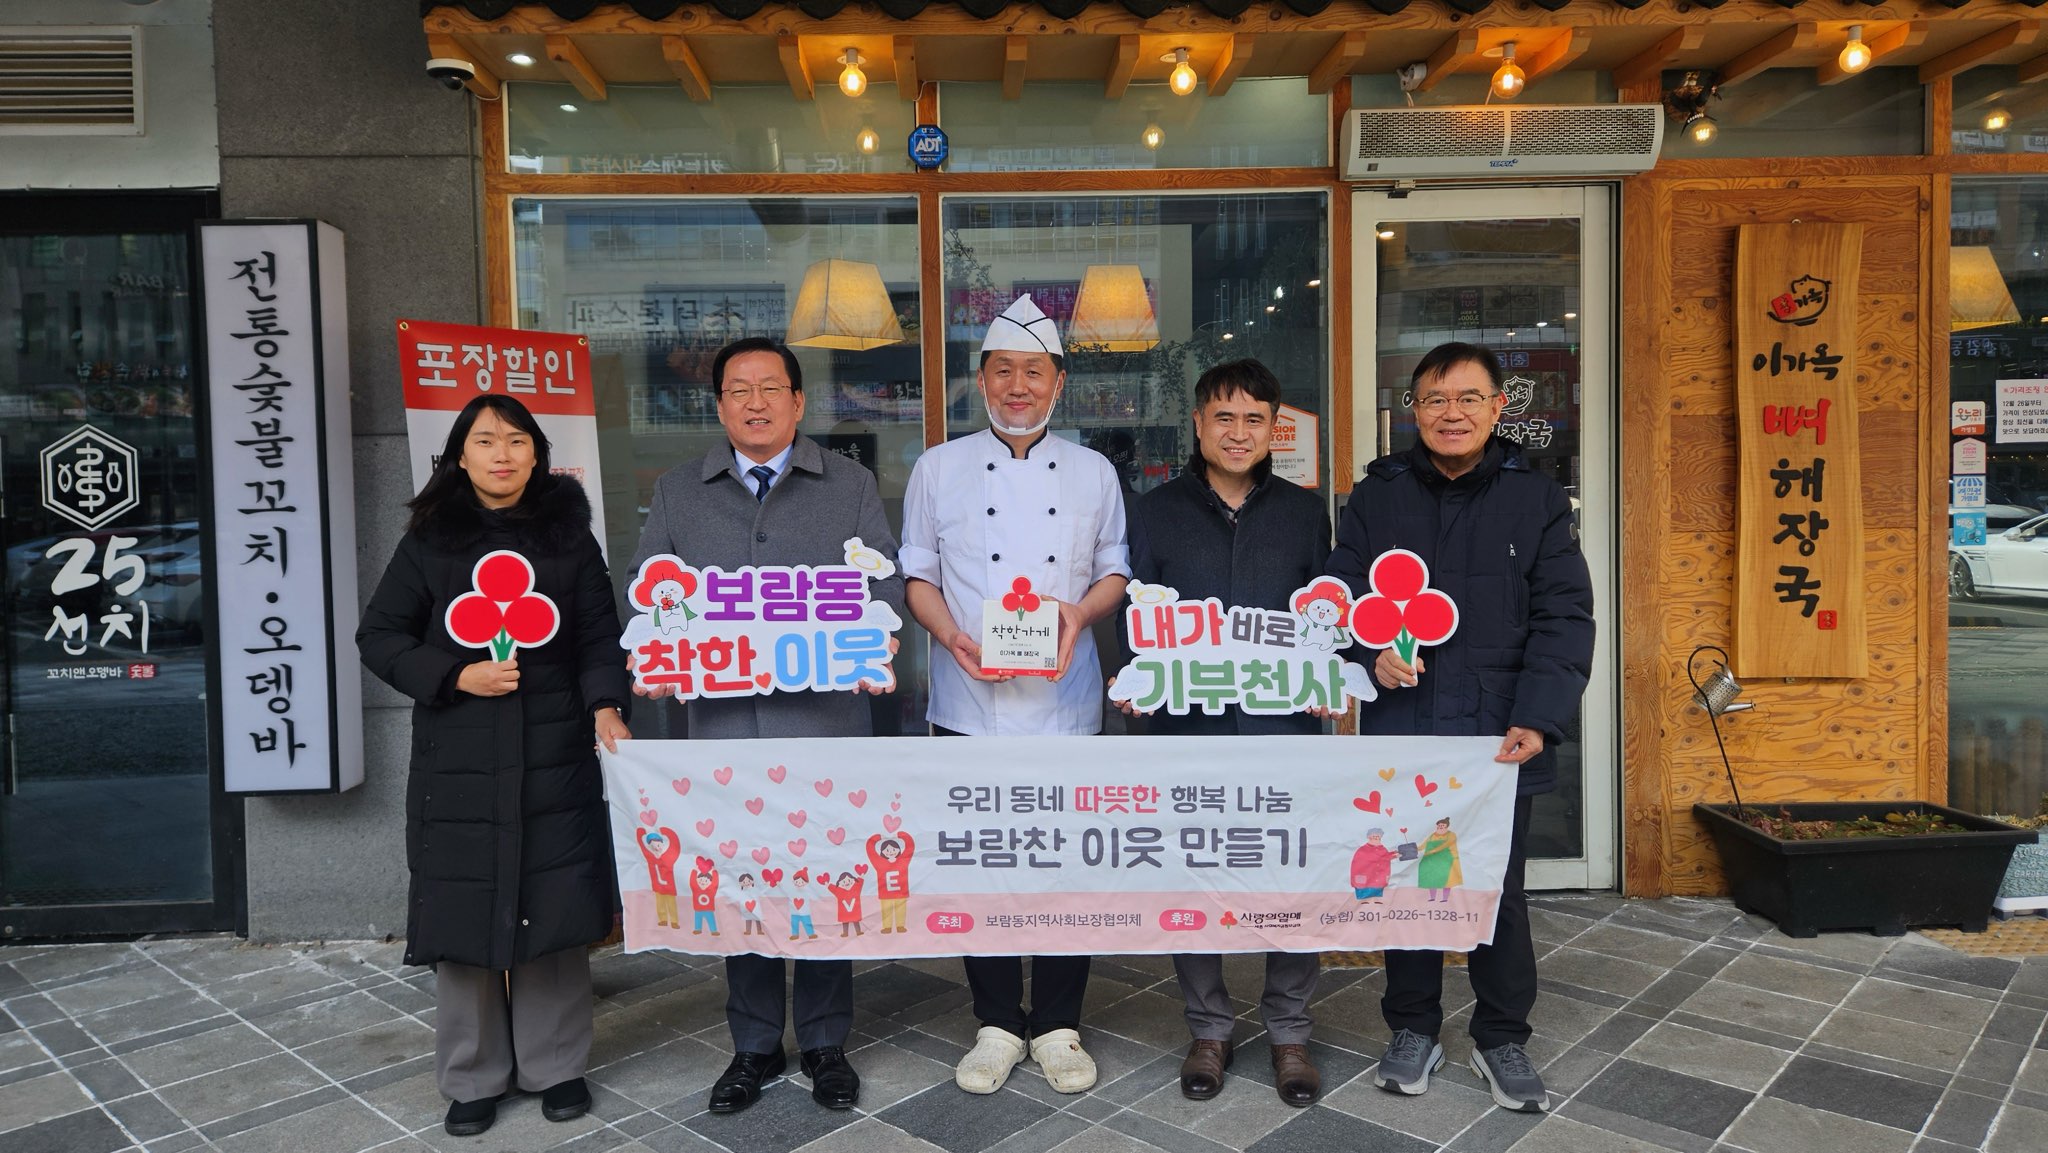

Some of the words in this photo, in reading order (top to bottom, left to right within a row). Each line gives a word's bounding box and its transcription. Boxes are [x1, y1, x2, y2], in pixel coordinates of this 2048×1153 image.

[915, 137, 941, 152] ADT
[416, 342, 576, 394] 포장할인
[1753, 342, 1843, 380] 이가옥
[1273, 425, 1296, 433] SION
[45, 534, 146, 596] 25
[704, 571, 865, 622] 보람동
[992, 624, 1050, 640] 착한가게
[1131, 603, 1224, 649] 내가
[1231, 611, 1296, 648] 바로
[46, 666, 123, 679] 꼬치앤오뎅바
[638, 635, 757, 694] 착한
[775, 628, 888, 687] 이웃
[1135, 659, 1346, 709] 기부천사
[947, 785, 1001, 814] 우리
[1010, 785, 1064, 813] 동네
[1074, 784, 1161, 814] 따뜻한
[1170, 785, 1226, 813] 행복
[1237, 785, 1293, 813] 나눔
[935, 826, 1067, 868] 보람찬
[1082, 827, 1165, 868] 이웃
[1180, 827, 1307, 868] 만들기
[937, 915, 962, 928] 주최
[985, 913, 1142, 928] 보람동지역사회보장협의체
[1170, 912, 1195, 926] 후원
[1320, 911, 1354, 925] (농협)
[1358, 909, 1479, 923] 301-0226-1328-11
